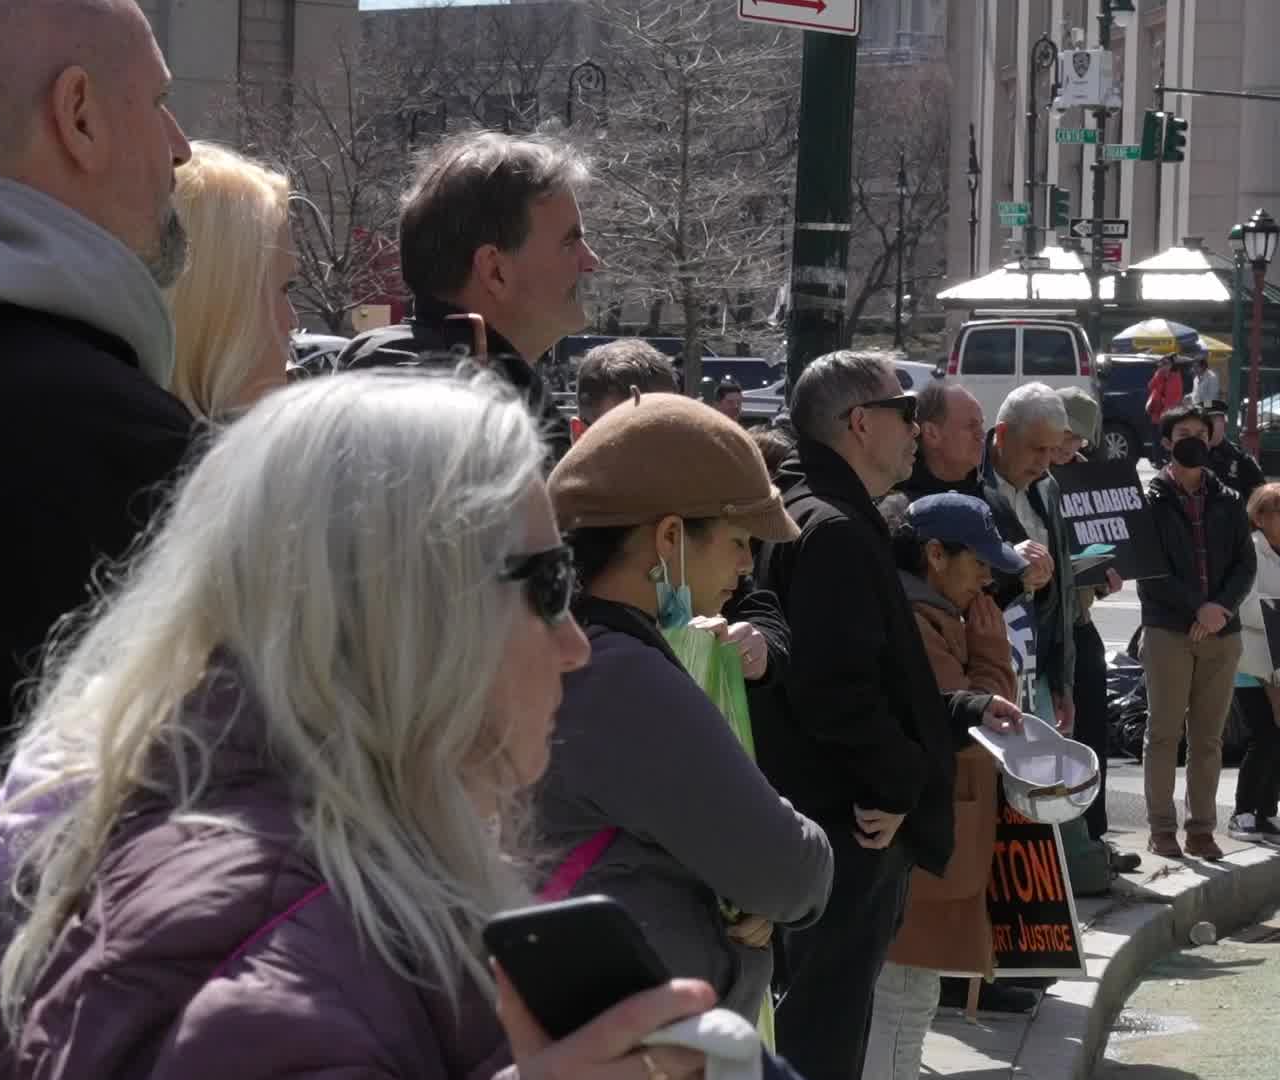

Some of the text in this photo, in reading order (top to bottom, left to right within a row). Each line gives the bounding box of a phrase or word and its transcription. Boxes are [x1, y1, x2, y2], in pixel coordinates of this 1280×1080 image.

[1060, 486, 1142, 519] LACK BABIES
[1073, 517, 1130, 545] MATTER
[992, 839, 1064, 902] TONI
[1018, 913, 1073, 952] JUSTICE
